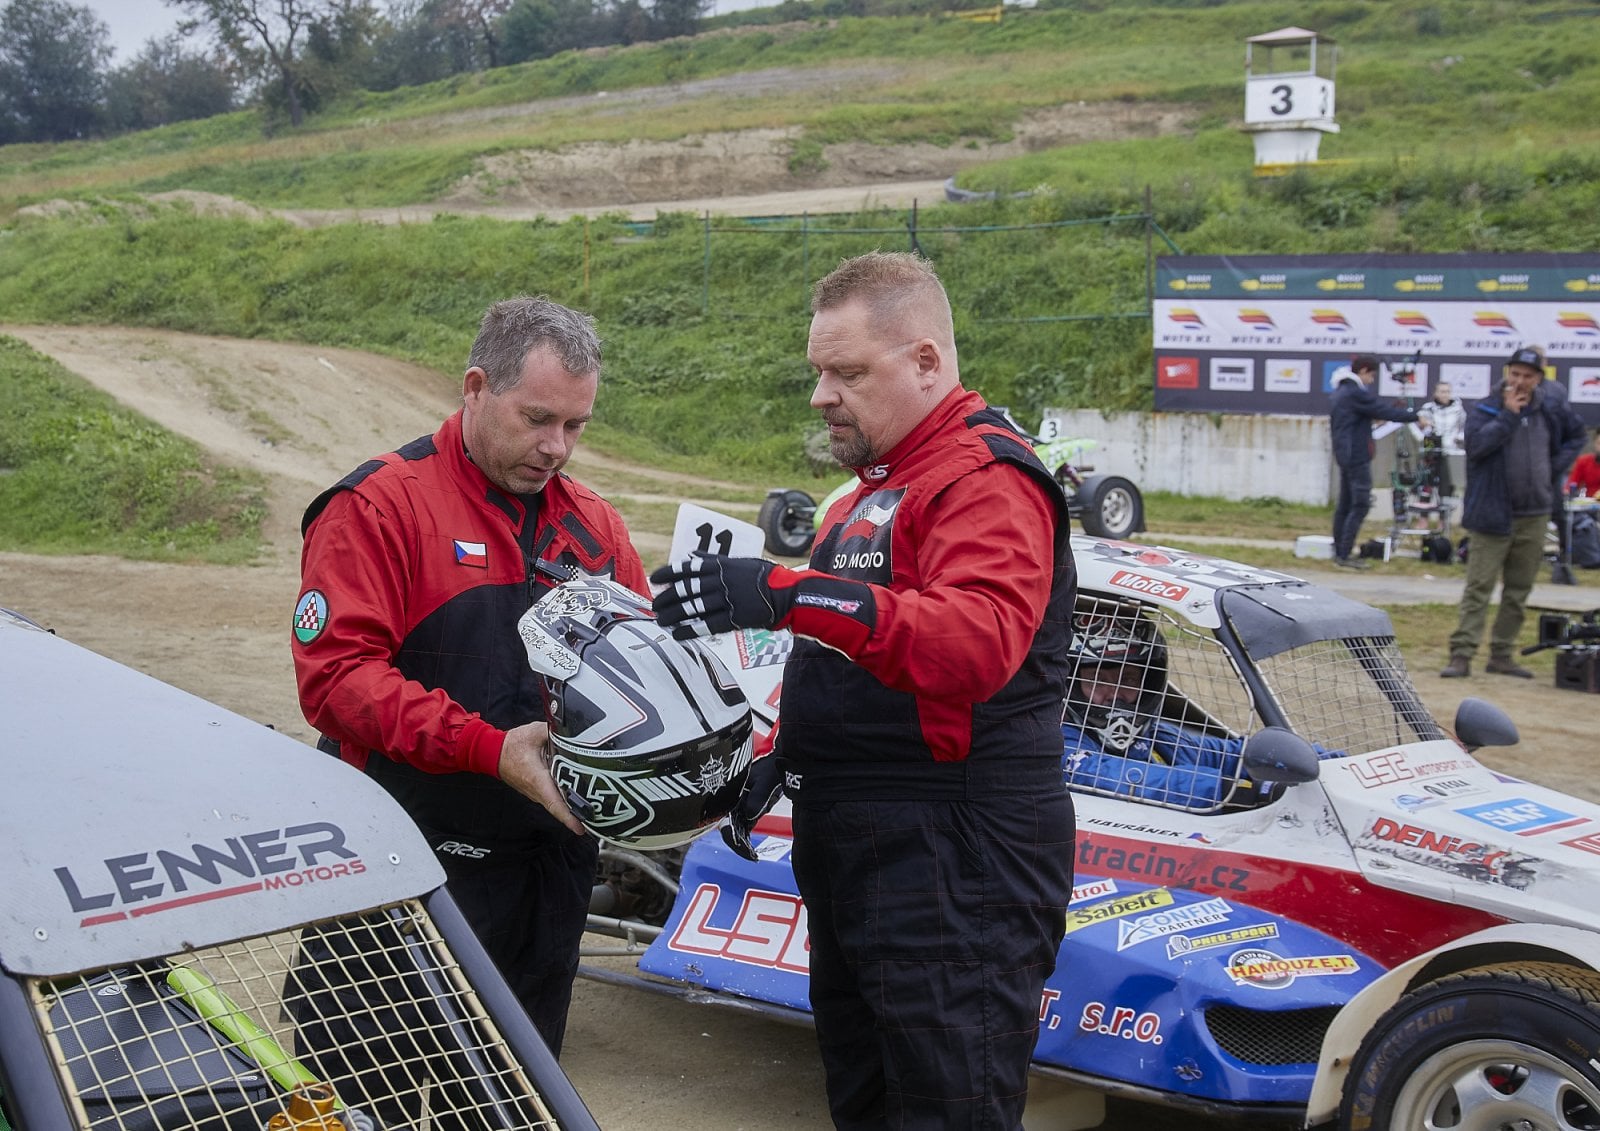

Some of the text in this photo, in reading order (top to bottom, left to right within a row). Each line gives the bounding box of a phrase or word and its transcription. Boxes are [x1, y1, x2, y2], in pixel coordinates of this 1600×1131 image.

[1271, 85, 1293, 115] 3
[1049, 421, 1058, 438] 3
[696, 522, 733, 557] 11
[833, 551, 884, 569] SD MOTO
[1116, 573, 1182, 597] MoTeC
[1474, 803, 1547, 826] SKF
[436, 841, 491, 858] RRS
[263, 859, 367, 891] MOTORS
[1072, 883, 1112, 900] trol
[1074, 893, 1160, 924] Sabelt
[1158, 914, 1223, 934] PARTNER
[1191, 925, 1276, 948] PNEU-SPORT
[1231, 959, 1319, 978] HAMOUZ
[1079, 1002, 1164, 1045] s.r.o.
